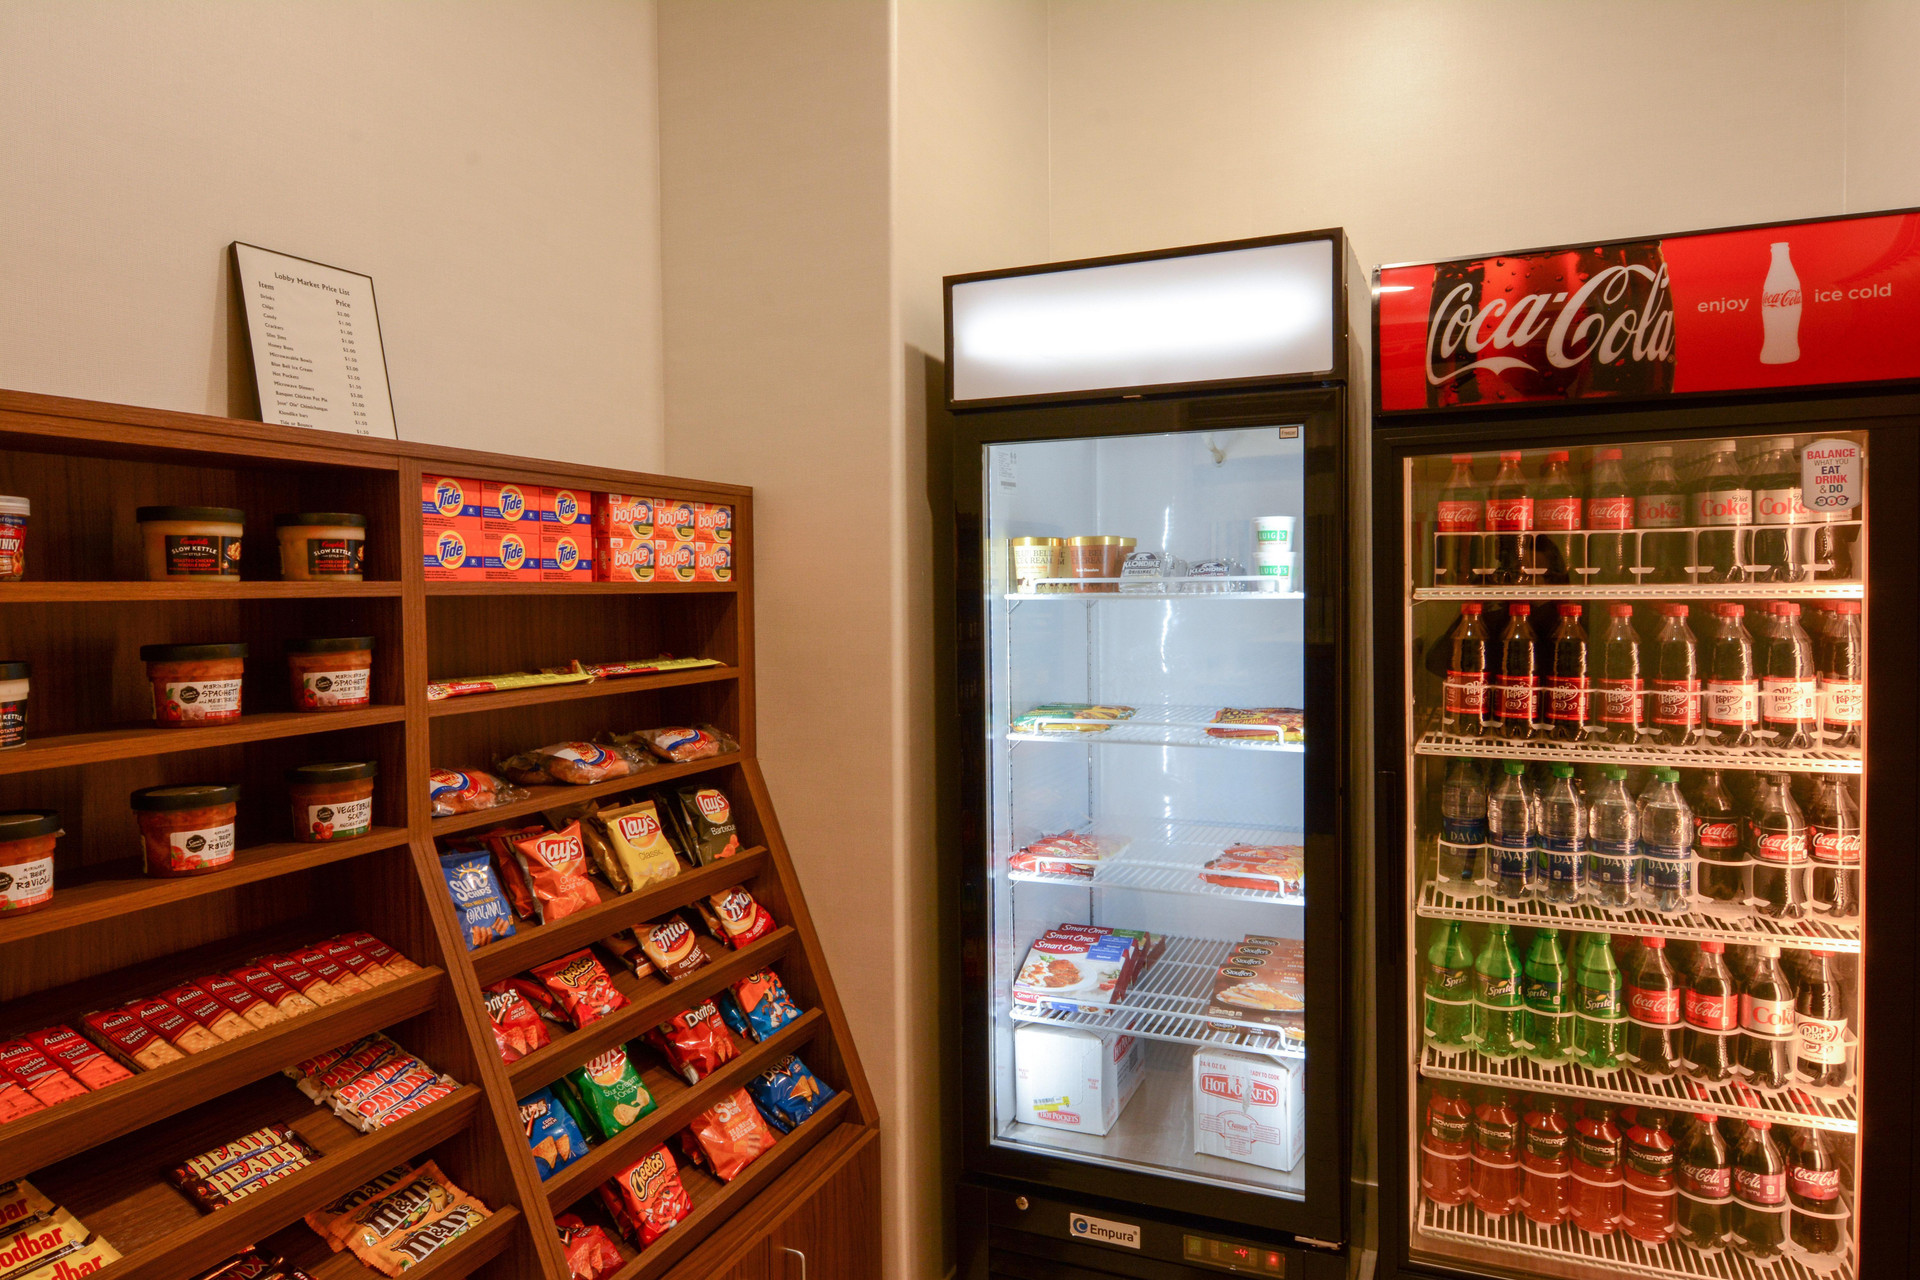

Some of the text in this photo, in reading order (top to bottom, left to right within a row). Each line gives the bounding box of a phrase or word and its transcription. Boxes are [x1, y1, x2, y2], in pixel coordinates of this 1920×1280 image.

[259, 281, 274, 290] Item
[275, 272, 350, 296] Lobby Market Price List
[1763, 289, 1802, 308] Coca-Cola
[1814, 283, 1892, 303] ice cold
[336, 299, 350, 308] Price
[1697, 296, 1749, 314] enjoy
[1427, 263, 1675, 385] Coca-Cola
[1807, 449, 1855, 460] BALANCE
[1821, 466, 1840, 475] EAT
[1815, 475, 1847, 484] DRINK
[1820, 484, 1843, 493] & DO
[438, 488, 461, 509] Tide
[501, 494, 522, 514] Tide
[557, 499, 576, 518] Tide
[613, 505, 646, 522] bounce
[1438, 508, 1477, 522] Coca-Cola
[1488, 505, 1528, 521] Coca-Cola
[1588, 503, 1629, 519] Coca-Cola
[1638, 502, 1681, 520] Coke
[1702, 499, 1748, 517] Coke
[659, 509, 688, 525] bounce
[700, 512, 726, 527] bounce
[171, 546, 217, 554] SLOW KETTLE
[439, 541, 463, 562] Tide
[502, 543, 523, 564] Tide
[558, 545, 576, 564] Tide
[615, 548, 649, 566] bounce
[659, 549, 689, 566] bounce
[700, 551, 726, 567] bounce
[1125, 560, 1161, 568] KLONDIKE
[701, 794, 725, 814] Lay's
[622, 816, 656, 839] Lay's
[1758, 834, 1806, 851] Coca-Cola
[1813, 833, 1860, 851] Coca-Cola
[541, 839, 581, 865] Lay's
[639, 849, 664, 860] Classic
[467, 887, 492, 898] CHIPS
[466, 901, 505, 924] ORIGINAL
[355, 937, 375, 946] Austin
[1035, 941, 1062, 949] Smart
[1063, 944, 1085, 952] Ones
[329, 945, 350, 955] Austin
[371, 947, 386, 955] Peanut
[376, 949, 390, 957] Butter
[273, 960, 296, 970] Austin
[302, 954, 325, 964] Austin
[346, 955, 362, 964] Peanut
[351, 957, 365, 966] Butter
[246, 971, 271, 982] Austin
[290, 971, 307, 979] Peanut
[319, 964, 335, 974] Peanut
[324, 967, 339, 975] Butter
[556, 959, 594, 986] Cheetos
[1226, 969, 1253, 977] Stouffer's
[295, 973, 311, 981] Butter
[1445, 976, 1466, 986] Sprite
[211, 981, 236, 991] Austin
[263, 983, 282, 992] Peanut
[1488, 986, 1513, 995] Sprite
[1527, 988, 1547, 997] Sprite
[176, 990, 204, 1005] Austin
[229, 992, 248, 1001] Peanut
[234, 995, 252, 1003] Butter
[1632, 994, 1676, 1012] Coca-Cola
[140, 1003, 169, 1018] Austin
[194, 1001, 215, 1015] Peanut
[200, 1005, 219, 1017] Butter
[1586, 1000, 1612, 1010] Sprite
[103, 1016, 133, 1029] Austin
[159, 1015, 181, 1028] Peanut
[686, 1002, 716, 1028] Doritos
[165, 1018, 185, 1031] Butter
[44, 1031, 75, 1045] Austin
[121, 1026, 144, 1043] Peanut
[126, 1030, 148, 1045] Butter
[0, 1045, 33, 1060] Austin
[59, 1043, 87, 1057] Cheddar
[66, 1047, 90, 1059] Cheese
[15, 1057, 44, 1073] Cheddar
[22, 1061, 48, 1076] Cheese
[616, 1075, 638, 1092] Cream
[1205, 1077, 1274, 1102] HOT POKETS
[357, 1069, 436, 1117] PAYDAY
[1052, 1112, 1079, 1122] POCKETS
[184, 1127, 282, 1179] HEATH
[205, 1142, 304, 1195] HEATH
[631, 1152, 664, 1200] Cheetos
[1794, 1167, 1838, 1186] Coca-Cola
[1090, 1224, 1134, 1242] Empura
